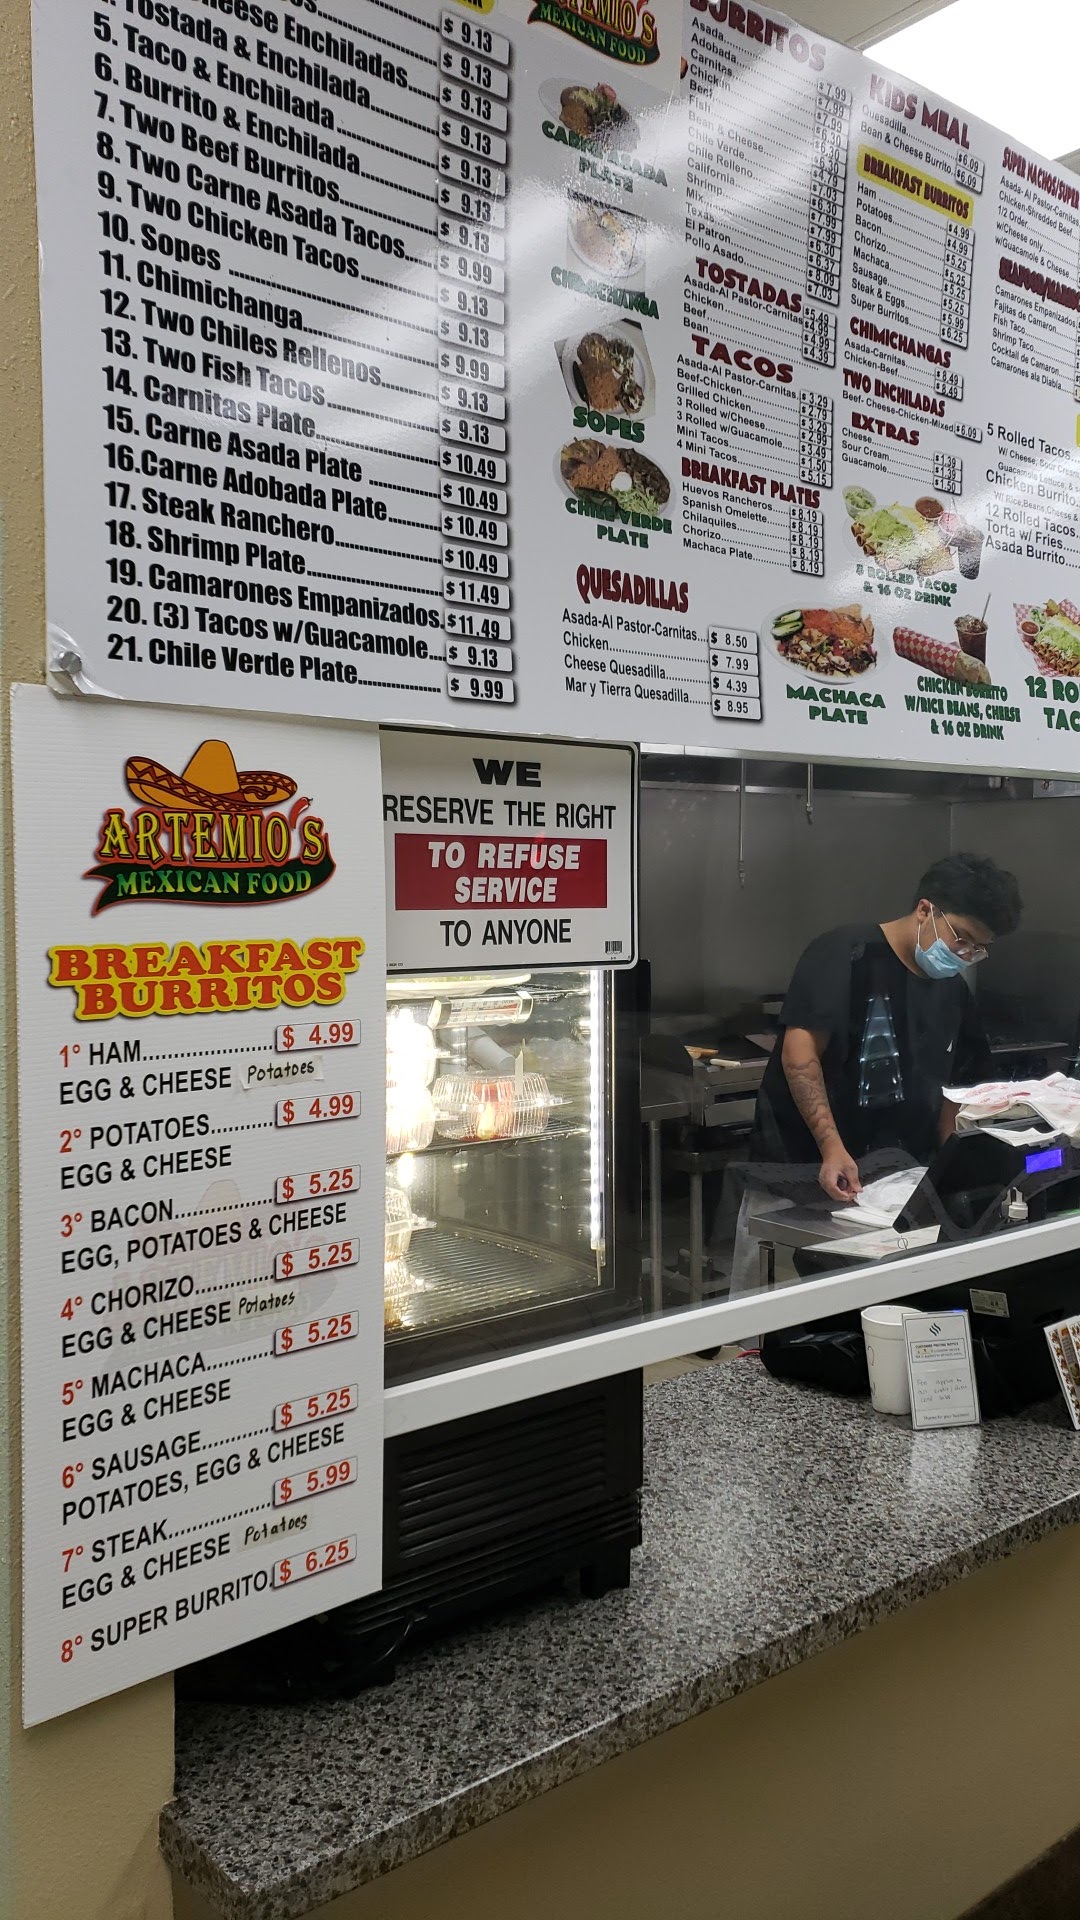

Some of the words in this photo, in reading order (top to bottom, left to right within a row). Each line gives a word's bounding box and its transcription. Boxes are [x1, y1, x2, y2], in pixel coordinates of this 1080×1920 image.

[541, 6, 606, 46] MEXICAN
[610, 38, 645, 64] FOOD
[93, 11, 117, 46] 5.
[122, 22, 186, 71] Taco
[192, 56, 210, 83] &
[216, 60, 334, 130] Enchilada
[94, 51, 118, 85] 6.
[124, 62, 217, 121] Burrito
[222, 105, 240, 132] &
[245, 109, 359, 175] Enchilada
[921, 101, 970, 150] MEAL
[93, 89, 114, 123] 7.
[119, 99, 174, 143] Two
[181, 122, 238, 167] Beef
[244, 145, 339, 202] Burritos
[857, 182, 876, 198] Ham
[855, 215, 881, 233] Bacon
[856, 198, 892, 221] Potatoes
[97, 210, 135, 245] 10.
[140, 223, 220, 270] Sopes
[854, 231, 886, 252] Chorizo
[852, 263, 887, 285] Sausage
[853, 247, 889, 269] Machaca
[98, 249, 130, 282] 11.
[136, 259, 302, 330] Chimichanga
[696, 257, 802, 312] TOSTADAS
[851, 295, 874, 312] Super
[877, 305, 908, 324] Burritos
[993, 312, 1012, 328] Fish
[1013, 321, 1025, 334] Taco
[849, 316, 951, 368] CHIMICHANGAS
[992, 325, 1017, 345] Shrimp
[1018, 336, 1034, 352] Taco
[691, 334, 794, 383] TACOS
[677, 369, 741, 395] Beef-Chicken
[677, 383, 710, 402] Grilled
[713, 393, 750, 412] Chicken
[573, 406, 645, 443] SOPES
[677, 411, 681, 422] 3
[685, 413, 717, 431] Rolled
[720, 422, 782, 447] w/Guacamole
[677, 426, 698, 439] Mini
[701, 432, 728, 446] Tacos
[851, 412, 919, 445] EXTRAS
[987, 423, 994, 435] 5
[997, 426, 1035, 448] Rolled
[1039, 440, 1071, 460] Tacos
[102, 404, 139, 435] 15.
[145, 412, 220, 452] Carne
[226, 431, 300, 469] Asada
[305, 447, 361, 482] Plate
[442, 483, 452, 498] $
[457, 485, 498, 511] 10.49
[842, 440, 861, 453] Sour
[864, 446, 889, 460] Cream
[842, 453, 886, 471] Guacamole
[103, 442, 217, 488] 16.Carne
[222, 466, 326, 509] Adobada
[332, 488, 386, 520] Plate
[682, 457, 765, 496] BREAKFAST
[771, 477, 819, 508] PLATES
[682, 483, 719, 499] Huevos
[722, 491, 772, 510] Rancheros
[103, 480, 136, 510] 17.
[142, 487, 215, 524] Steak
[220, 501, 334, 544] Ranchero
[682, 497, 722, 514] Spanish
[725, 506, 766, 523] Omelette
[683, 511, 736, 530] Chilaquiles
[104, 519, 141, 549] 18.
[147, 525, 239, 566] Shrimp
[245, 541, 305, 574] Plate
[683, 525, 720, 539] Chorizo
[985, 518, 1016, 537] Torta
[1019, 526, 1032, 541] w/
[1035, 530, 1063, 549] Fries
[985, 535, 1023, 555] Asada
[1026, 545, 1065, 564] Burrito
[105, 557, 142, 587] 19.
[148, 563, 292, 607] Camarones
[297, 585, 439, 628] Empanizados
[577, 563, 689, 613] QUESADILLAS
[107, 594, 146, 625] 20.
[153, 601, 188, 629] (3)
[194, 606, 268, 639] Tacos
[272, 619, 428, 659] w/Guacamole
[448, 645, 457, 660] $
[467, 645, 497, 668] 9.13
[562, 607, 612, 629] Asada-Al
[616, 615, 697, 641] Pastor-Carnitas
[563, 630, 608, 650] Chicken
[107, 633, 142, 662] 21.
[148, 638, 216, 669] Chile
[221, 646, 294, 677] Verde
[299, 654, 357, 684] Plate
[450, 677, 459, 692] $
[469, 677, 503, 699] 9.99
[564, 653, 606, 672] Cheese
[609, 659, 665, 679] Quesadilla
[565, 676, 586, 692] Mar
[589, 682, 596, 697] y
[599, 679, 631, 697] Tierra
[634, 683, 689, 702] Quesadilla
[786, 683, 886, 709] MACHACA
[1024, 676, 1047, 698] 12
[809, 704, 868, 725] PLATE
[472, 758, 542, 788] WE
[383, 795, 494, 825] RESERVE
[504, 800, 545, 827] THE
[556, 803, 616, 829] RIGHT
[100, 800, 324, 863] ARTEMIO'S
[428, 841, 465, 869] TO
[478, 842, 581, 870] REFUSE
[116, 870, 240, 897] MEXICAN
[247, 869, 312, 894] FOOD
[455, 876, 558, 903] SERVICE
[440, 920, 471, 947] TO
[482, 918, 572, 946] ANYONE
[54, 940, 362, 982] BREAKFAST
[81, 972, 345, 1015] BURRITOS
[89, 1039, 140, 1065] HAM
[281, 1024, 294, 1051] $
[308, 1019, 353, 1044] 4.99
[60, 1077, 112, 1104] EGG
[119, 1075, 135, 1098] &
[142, 1066, 231, 1096] CHEESE
[247, 1060, 314, 1083] Potatoes
[90, 1113, 209, 1149] POTATOES
[281, 1098, 294, 1126] $
[308, 1091, 353, 1118] 4.99
[91, 1198, 172, 1232] BACON
[61, 1244, 118, 1274] EGG,
[127, 1221, 241, 1262] POTATOES
[248, 1217, 262, 1239] &
[268, 1201, 348, 1235] CHEESE
[90, 1274, 193, 1315] CHORIZO
[238, 1291, 295, 1315] Potatoes
[91, 1351, 205, 1398] MACHACA
[91, 1430, 200, 1480] SAUSAGE
[91, 1518, 167, 1562] STEAK
[90, 1605, 167, 1651] SUPER
[175, 1570, 267, 1621] BURRITO
